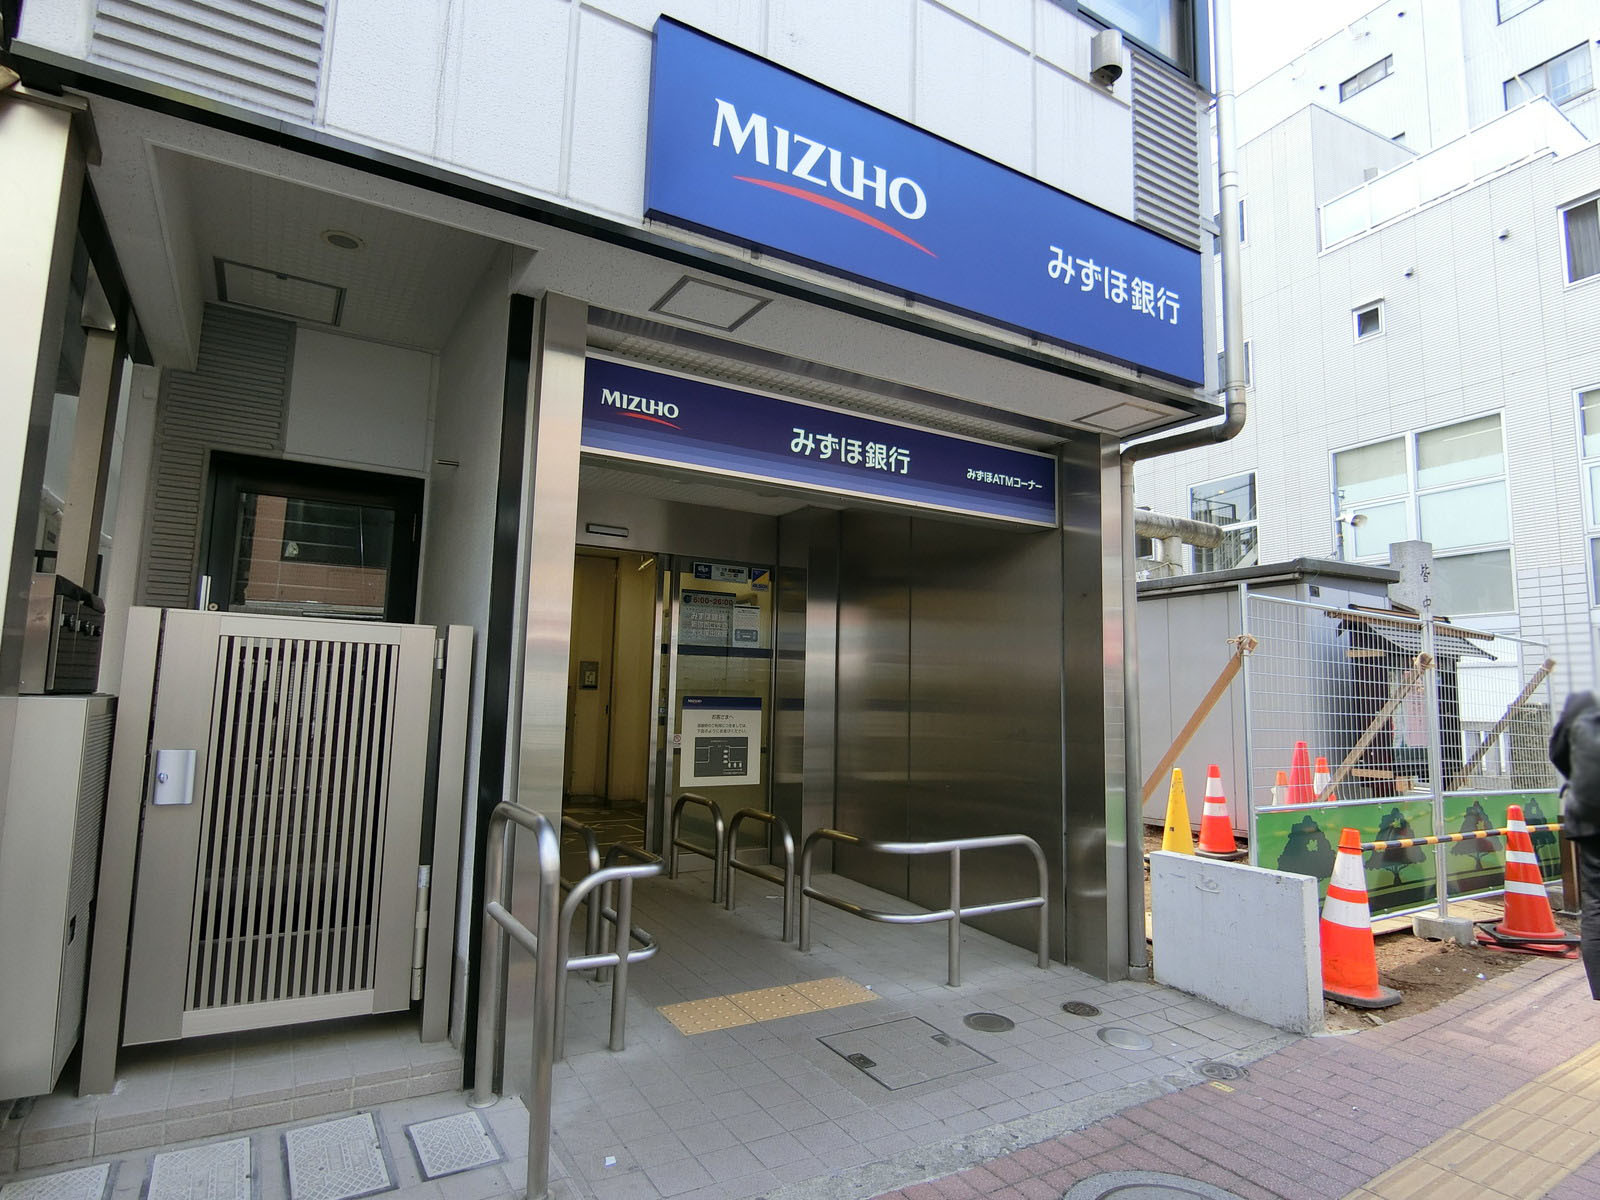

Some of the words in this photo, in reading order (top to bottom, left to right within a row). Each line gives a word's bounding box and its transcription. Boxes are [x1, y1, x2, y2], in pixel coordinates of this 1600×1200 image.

[712, 97, 927, 220] MIZUHO
[1048, 245, 1180, 325] みずほ銀行
[601, 388, 680, 418] MIZUHO
[790, 427, 911, 474] みずほ銀行
[966, 468, 1043, 490] みずほATMコーナー
